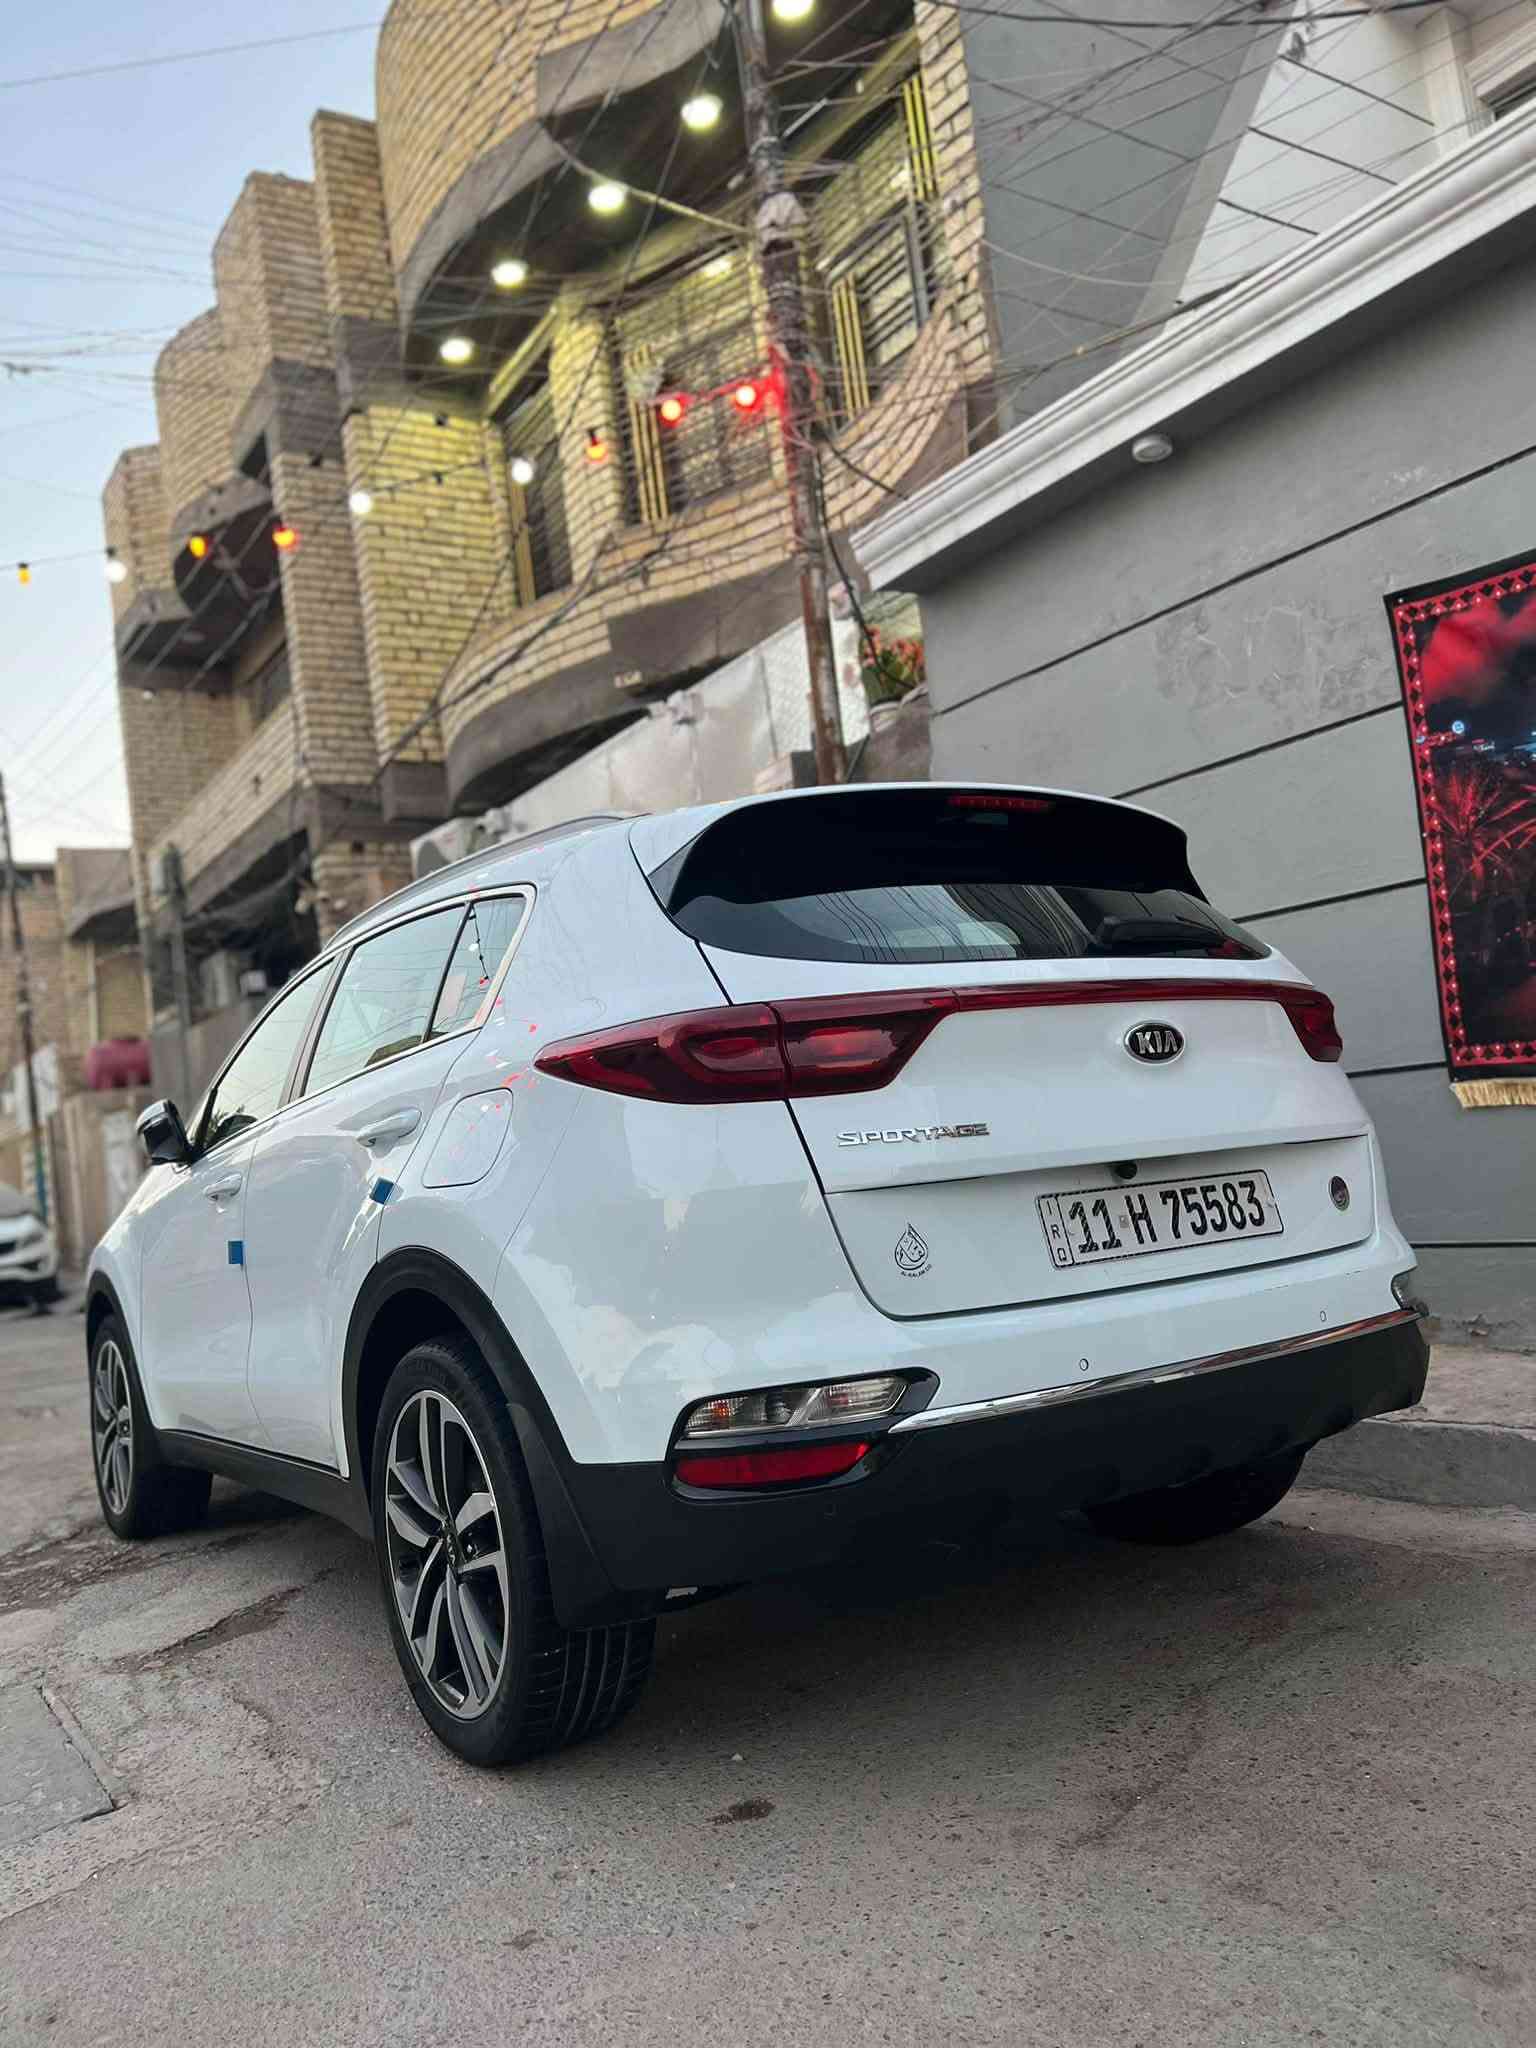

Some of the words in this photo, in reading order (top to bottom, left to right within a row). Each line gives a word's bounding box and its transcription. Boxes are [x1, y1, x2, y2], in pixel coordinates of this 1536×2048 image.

[1135, 1030, 1178, 1054] KIA
[837, 1122, 990, 1148] SPORTAGE
[1069, 1198, 1122, 1254] 11
[1125, 1193, 1158, 1245] H
[1159, 1179, 1265, 1239] 75583
